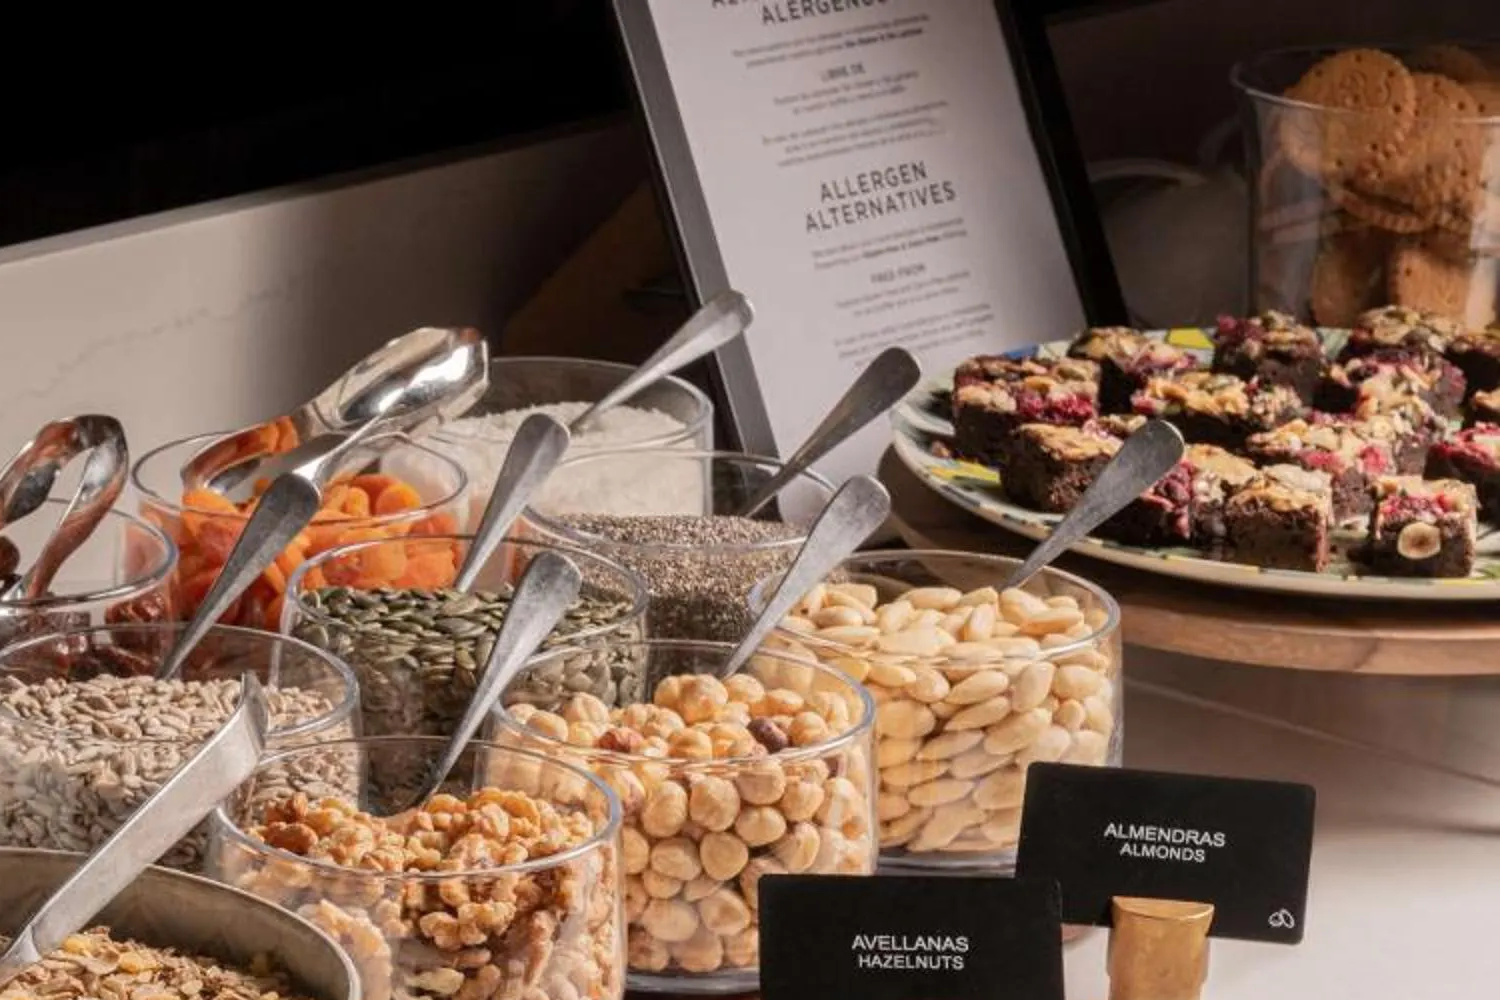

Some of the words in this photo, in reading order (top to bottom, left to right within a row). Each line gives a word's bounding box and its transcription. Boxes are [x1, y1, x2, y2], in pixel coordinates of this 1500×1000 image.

[761, 0, 888, 26] ALERGEN
[820, 161, 928, 203] ALLERGEN
[805, 181, 956, 233] ALTERNATIVES
[1103, 822, 1226, 847] ALMENDRAS
[1120, 842, 1205, 863] ALMONDS
[851, 934, 970, 953] AVELLANAS
[858, 953, 965, 970] HAZELNUTS
